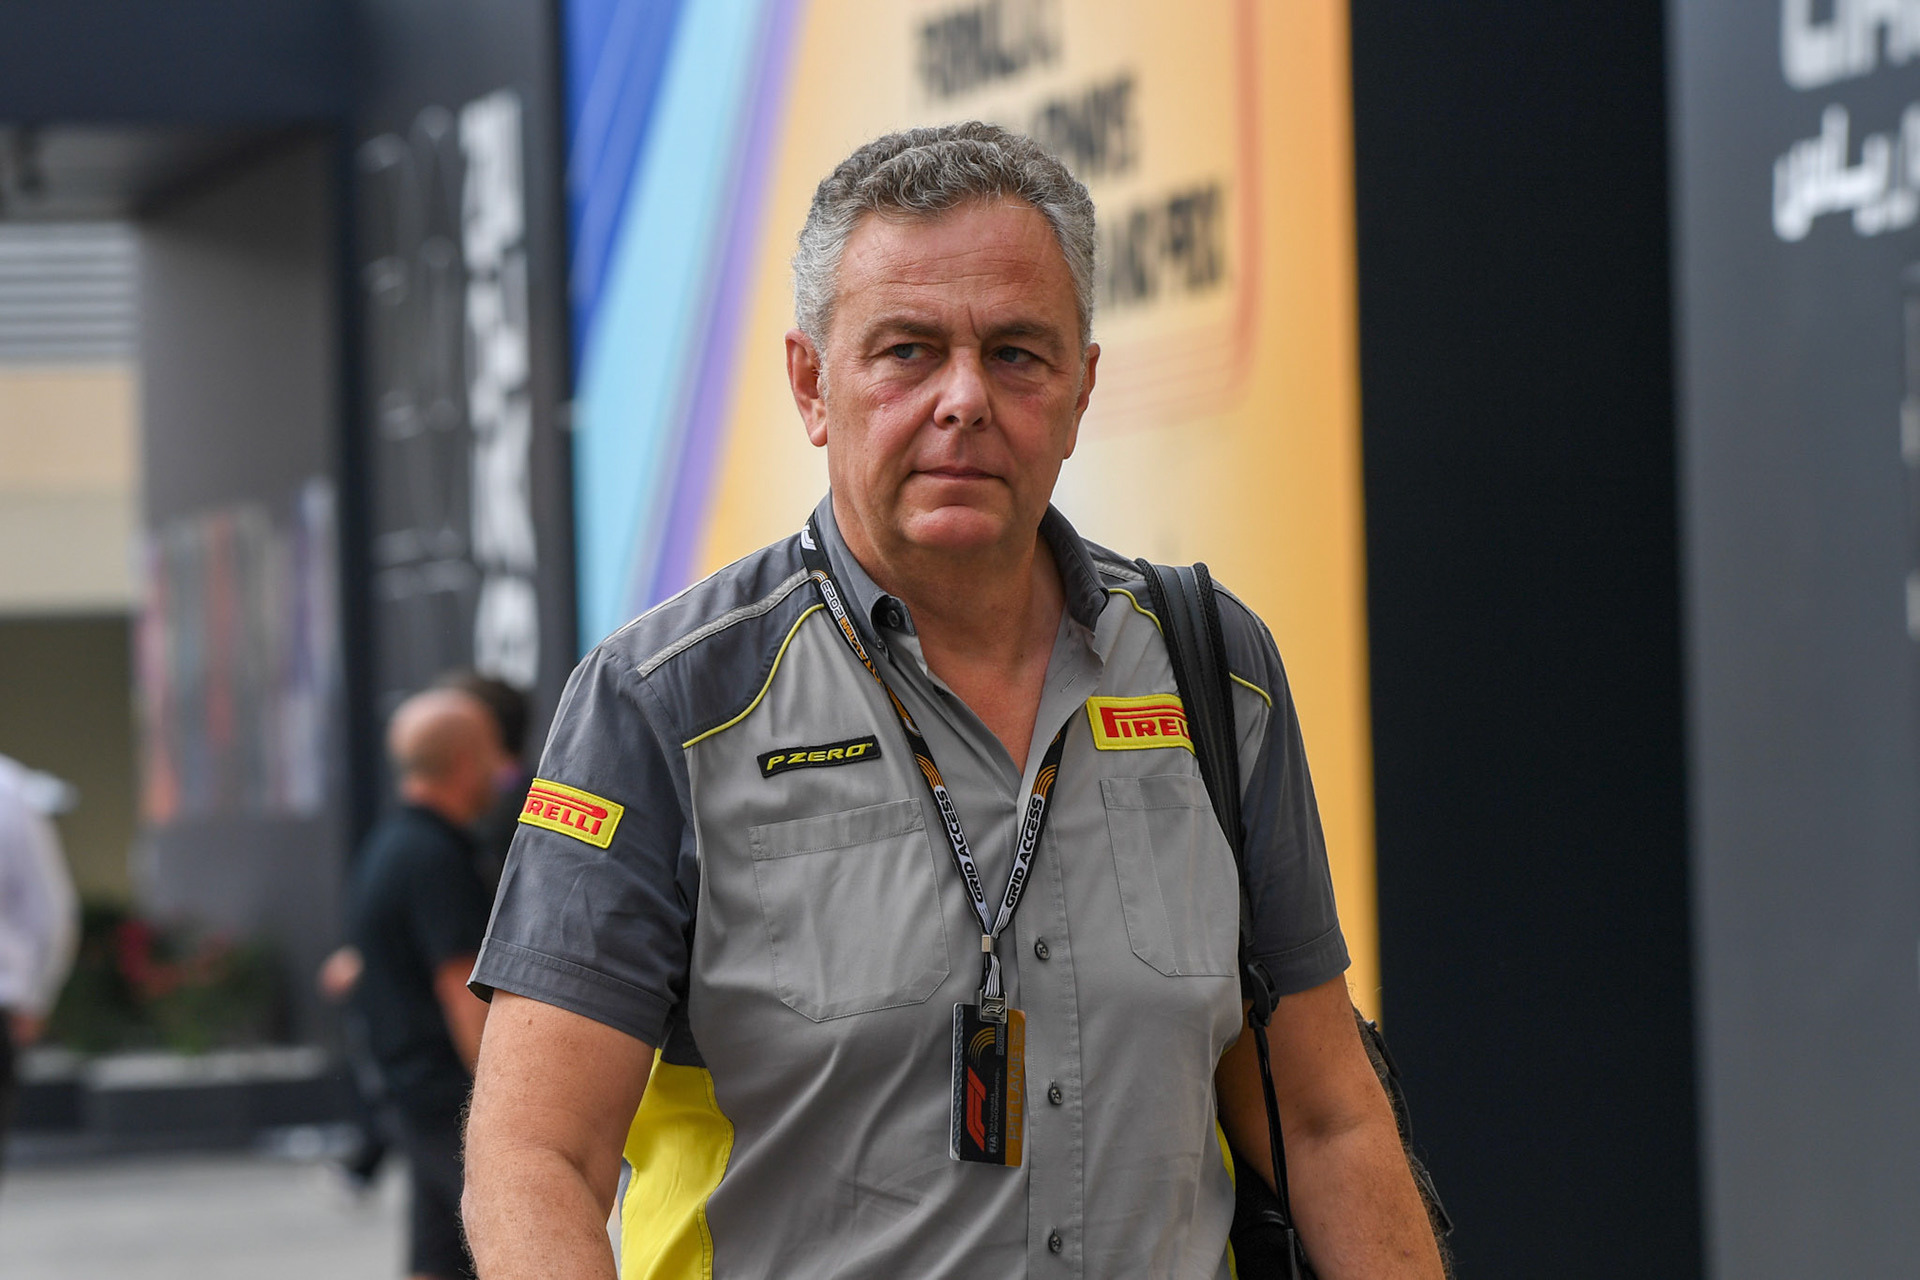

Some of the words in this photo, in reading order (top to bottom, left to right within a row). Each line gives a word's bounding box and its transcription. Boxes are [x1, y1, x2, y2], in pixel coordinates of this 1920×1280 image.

[821, 580, 843, 619] 2023
[1099, 705, 1191, 738] PIREL
[766, 755, 785, 771] P
[522, 787, 608, 835] RELLI
[935, 790, 971, 858] ACCESS
[1005, 866, 1025, 908] GRID
[1019, 797, 1043, 866] ACCESS
[962, 861, 984, 904] GRID
[1009, 1050, 1021, 1105] LANE
[1008, 1109, 1020, 1140] PIT
